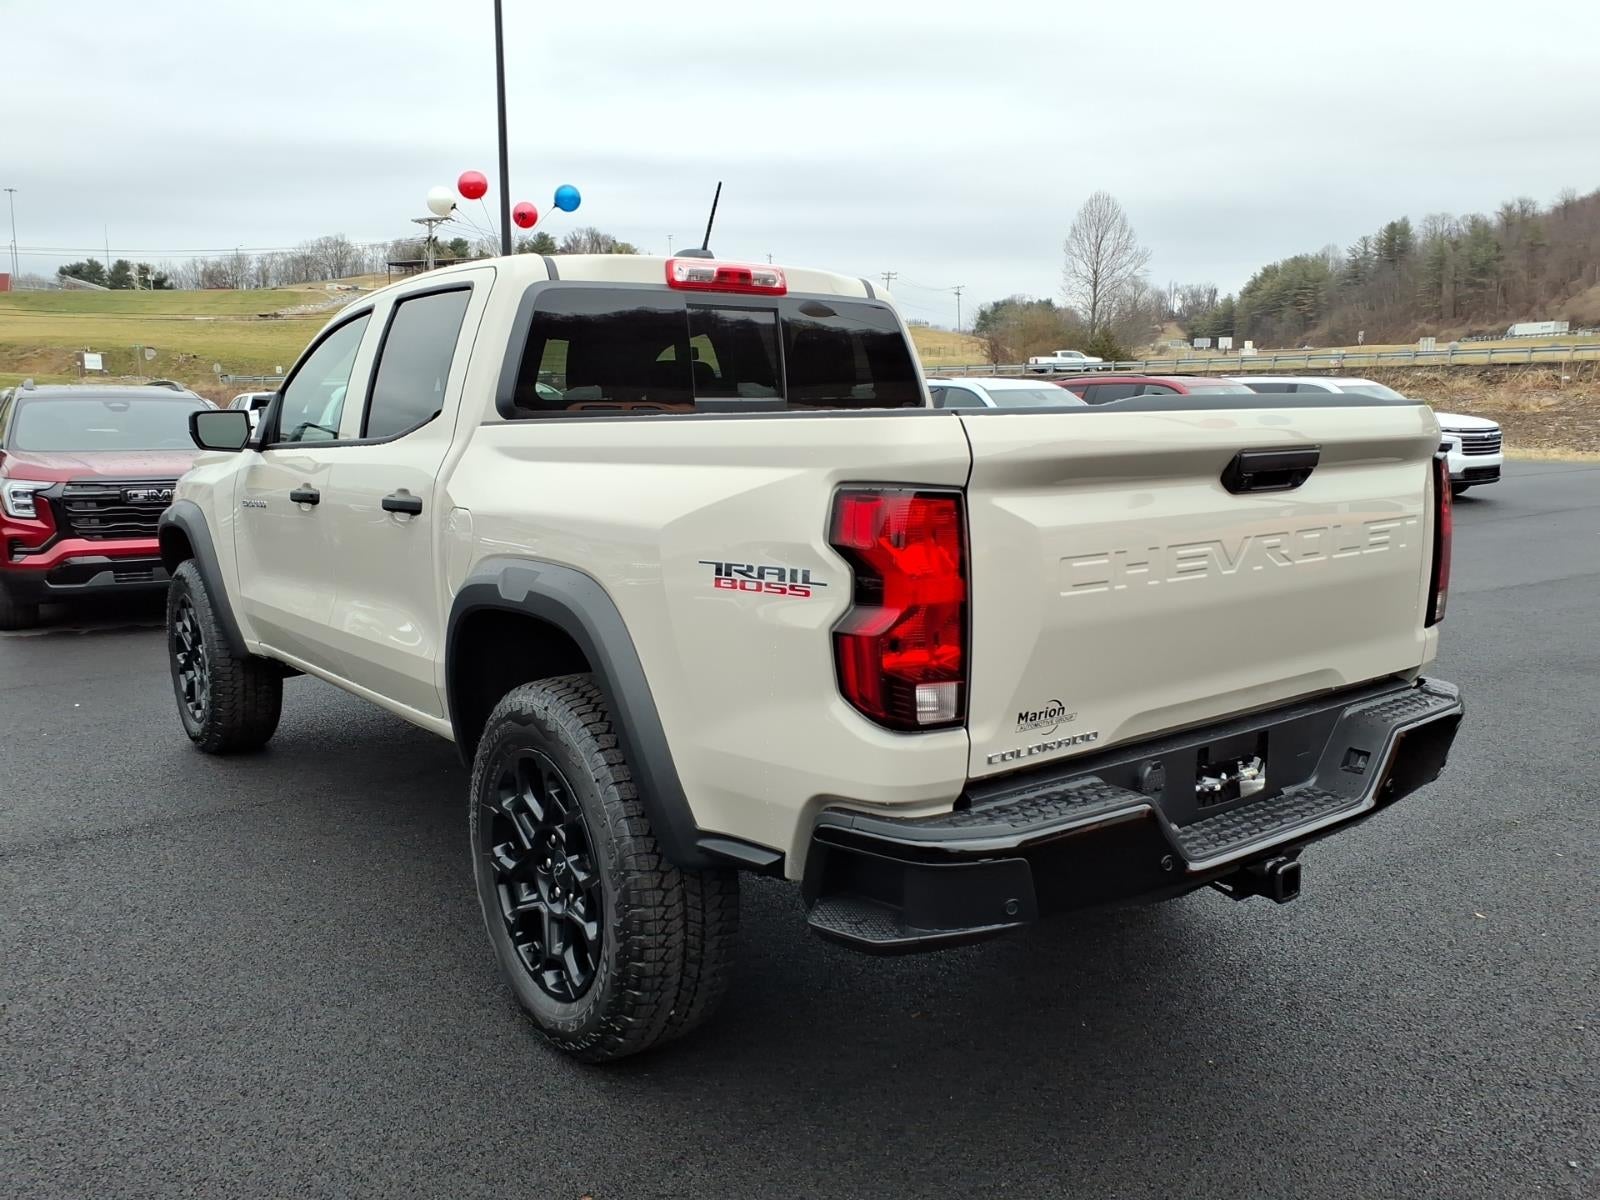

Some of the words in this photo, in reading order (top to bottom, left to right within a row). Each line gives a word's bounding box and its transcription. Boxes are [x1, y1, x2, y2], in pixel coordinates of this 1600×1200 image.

[127, 489, 175, 502] GM
[1060, 515, 1417, 596] CHEVROLET
[699, 561, 828, 586] TRAIL
[714, 577, 811, 597] BOSS
[1017, 706, 1066, 724] Marion
[987, 731, 1098, 765] COLORADO
